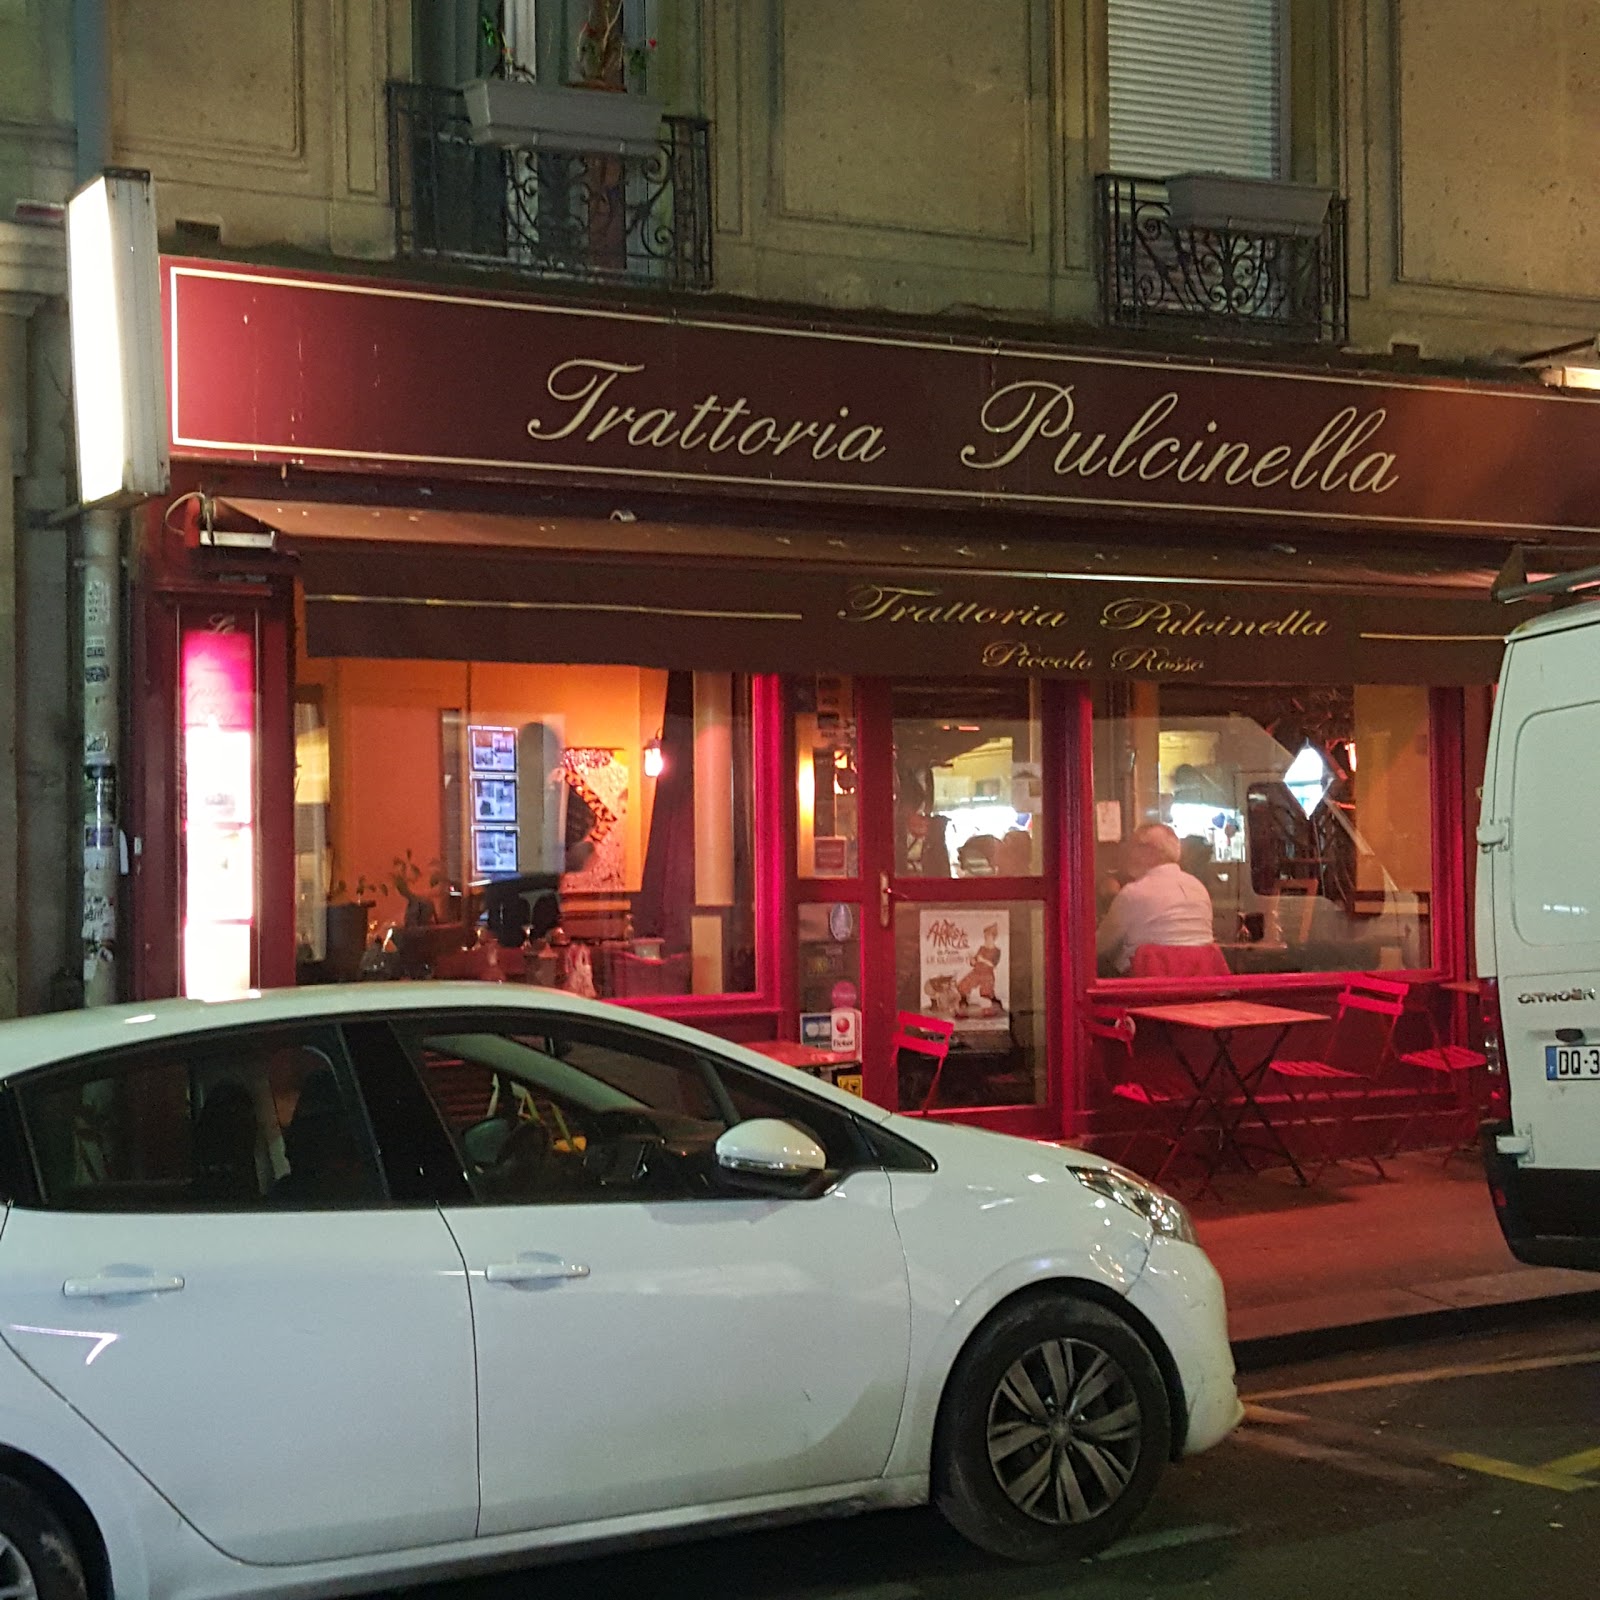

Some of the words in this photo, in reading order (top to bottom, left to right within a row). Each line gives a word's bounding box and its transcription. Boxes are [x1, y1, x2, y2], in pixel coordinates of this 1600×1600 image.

[526, 358, 888, 464] Trattoria
[960, 380, 1400, 494] Pulcinella
[837, 584, 1066, 629] Trattoria
[1100, 597, 1331, 638] Pulcinella
[981, 641, 1093, 671] Piccolo
